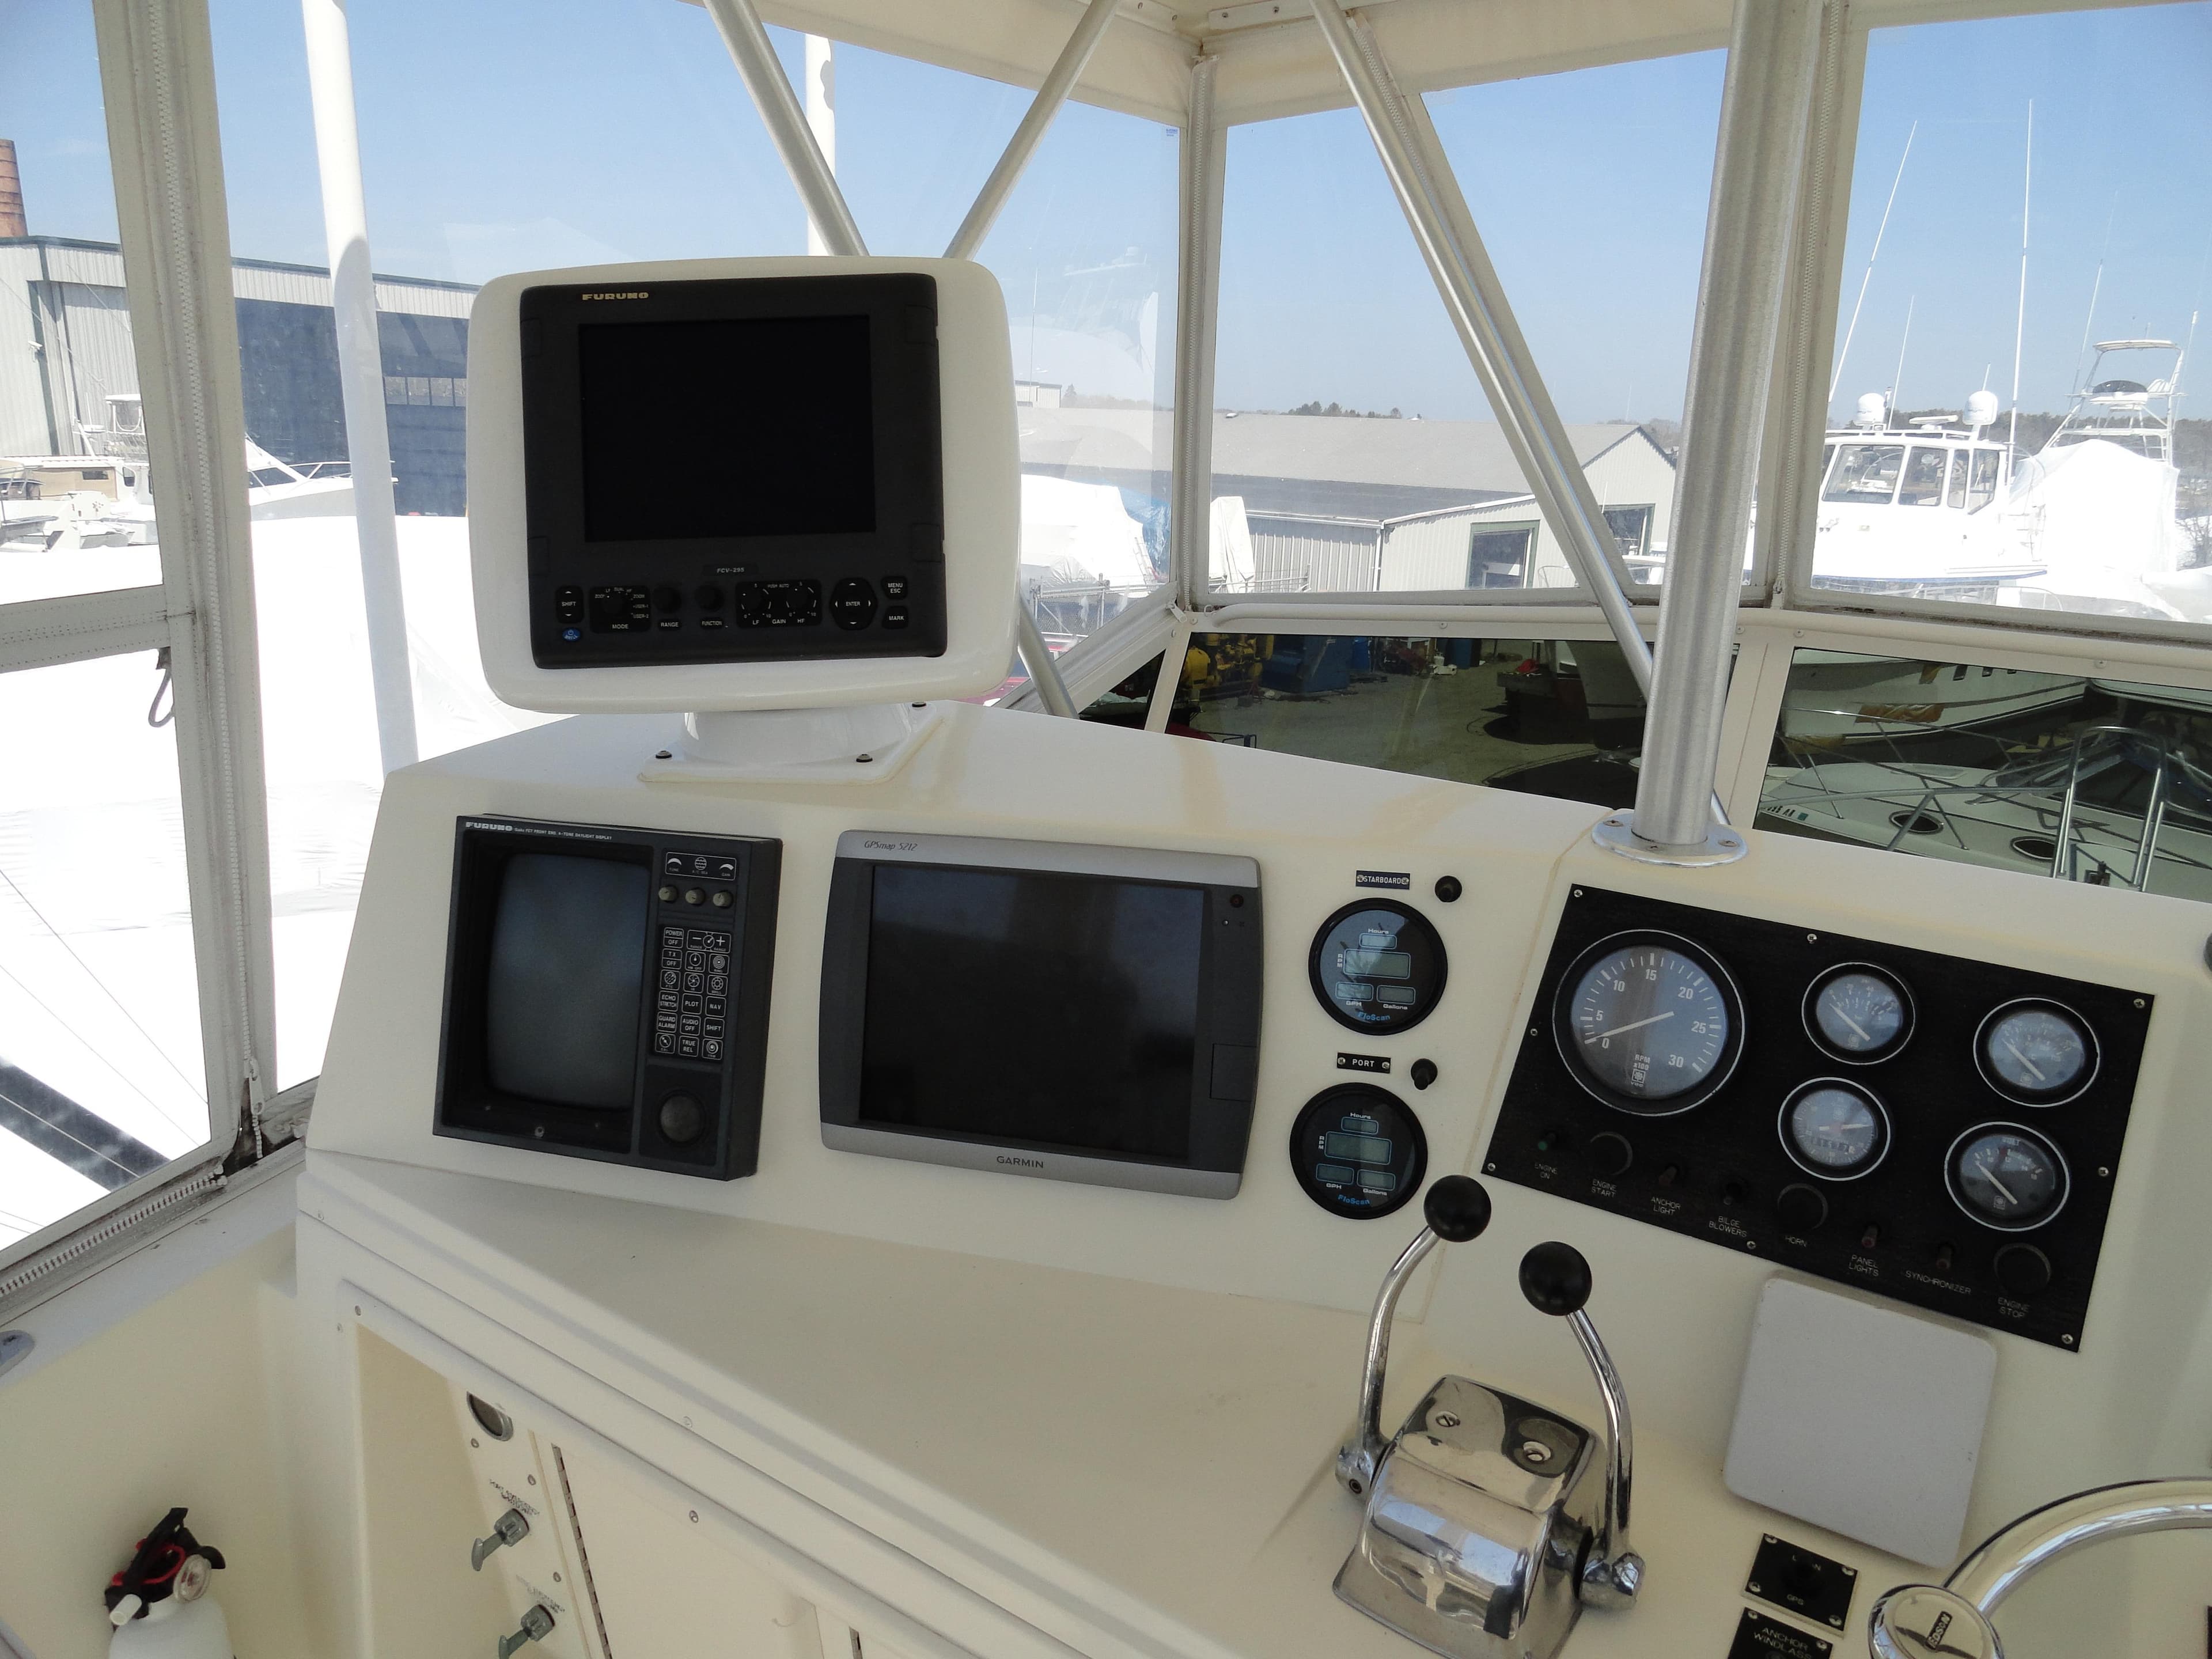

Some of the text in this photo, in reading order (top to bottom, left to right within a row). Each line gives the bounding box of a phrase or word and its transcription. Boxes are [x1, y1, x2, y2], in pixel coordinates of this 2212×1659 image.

[582, 292, 649, 301] FURUNO
[465, 821, 513, 831] FURUNO
[864, 840, 918, 851] GPSmap 5212
[1363, 875, 1402, 885] STARBOARD
[1645, 968, 1657, 981] 15
[1613, 979, 1626, 992] 10
[1677, 986, 1694, 999] 20
[1357, 1011, 1391, 1021] FloScan
[1596, 1010, 1604, 1021] 5
[1691, 1021, 1706, 1034] 25
[1601, 1037, 1609, 1049] 0
[1352, 1058, 1375, 1067] PORT
[1634, 1054, 1650, 1065] RPM
[1668, 1054, 1684, 1068] 30
[1633, 1062, 1650, 1071] x100
[1350, 1112, 1372, 1120] Hours
[996, 1156, 1044, 1169] GARMIN
[1534, 1161, 1558, 1175] ENGINE
[1539, 1171, 1551, 1180] ON
[1363, 1188, 1388, 1196] Gallons
[1591, 1186, 1617, 1198] START
[1592, 1179, 1617, 1193] ENGINE
[1338, 1194, 1370, 1205] FloScan
[1650, 1196, 1681, 1210] ANCHOR
[1653, 1205, 1676, 1216] LIGHT
[1718, 1215, 1741, 1228] BILGE
[1708, 1220, 1748, 1238] BLOWERS
[1785, 1235, 1807, 1248] HORN
[1851, 1254, 1878, 1268] PANEL
[1848, 1262, 1880, 1277] LIGHTS
[1905, 1270, 1972, 1295] SYNCHRONIZER
[1997, 1296, 2031, 1313] ENGINE
[1999, 1305, 2026, 1319] STOP
[1786, 1593, 1804, 1606] GPS
[1926, 1613, 1950, 1648] EDSON
[1753, 1631, 1812, 1659] WINDLASS
[1762, 1627, 1809, 1652] ANCHOR
